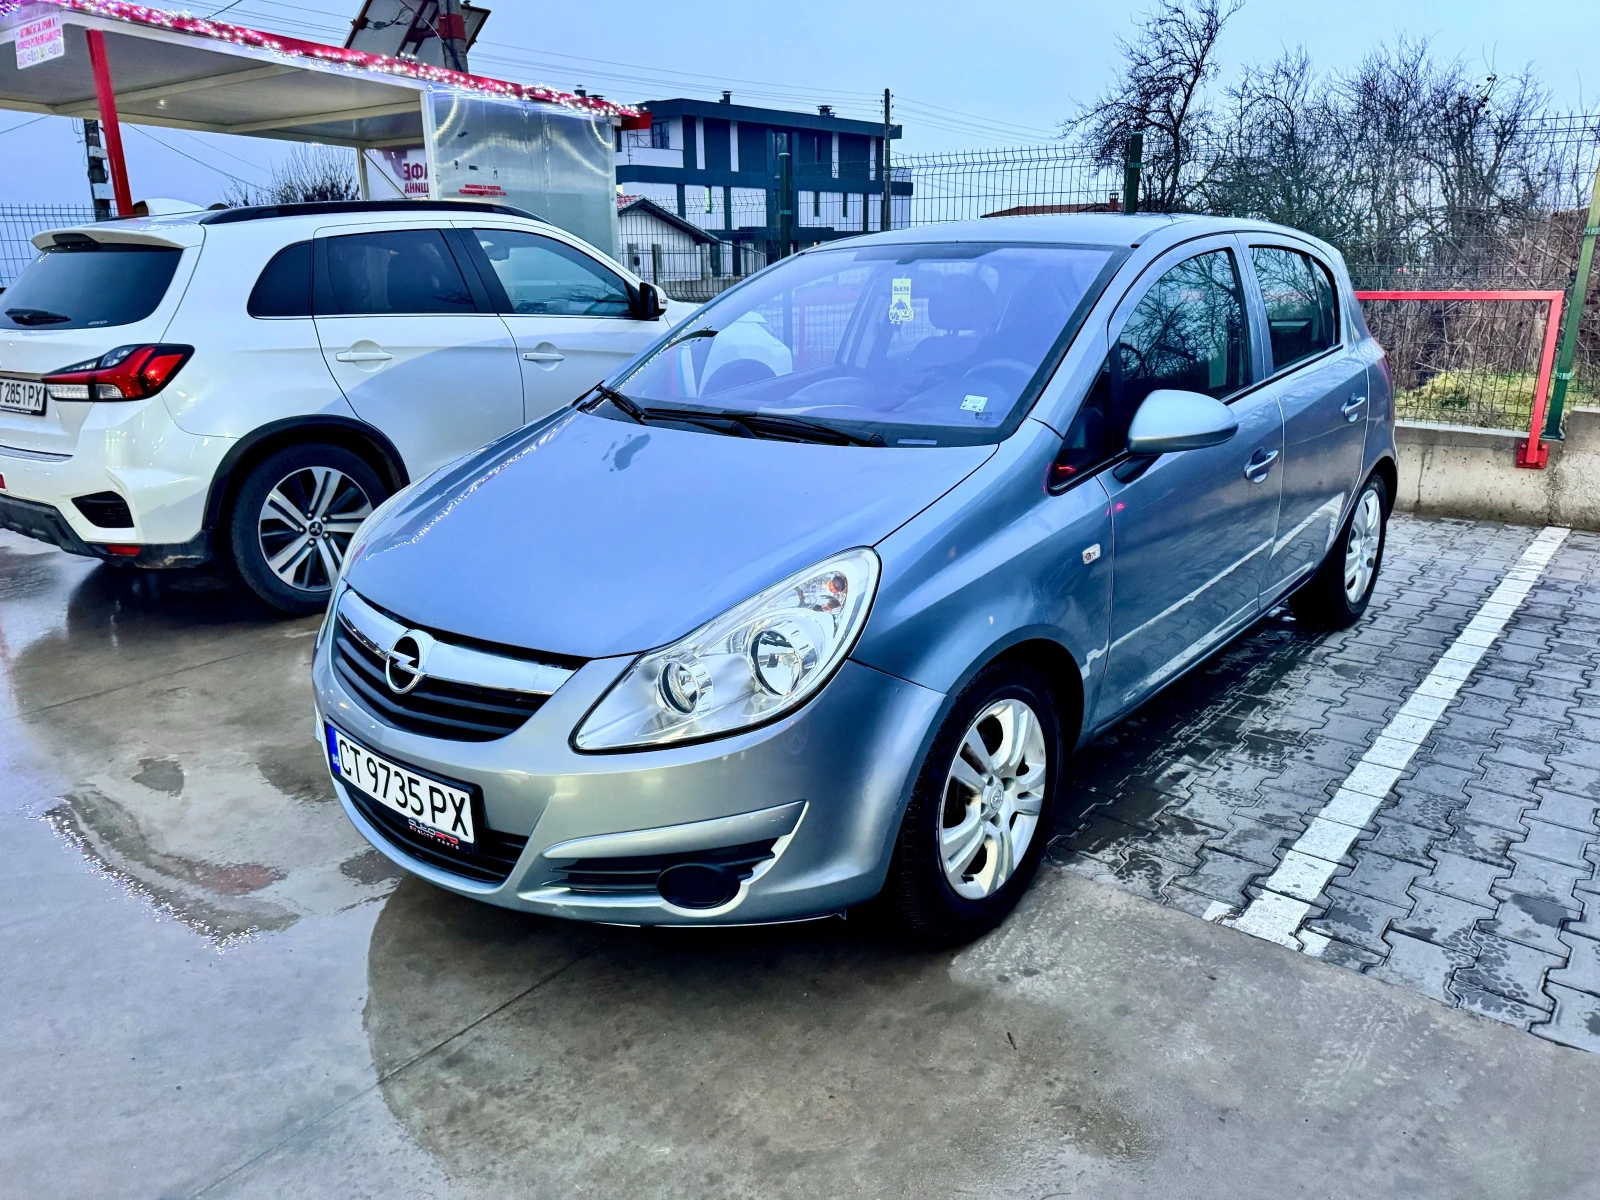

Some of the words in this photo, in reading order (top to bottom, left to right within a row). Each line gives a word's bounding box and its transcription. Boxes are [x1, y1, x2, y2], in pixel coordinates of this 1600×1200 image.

[5, 382, 26, 405] 2851
[27, 384, 43, 408] PX
[339, 739, 361, 784] CT
[366, 757, 424, 817] 9735
[429, 785, 470, 837] PX
